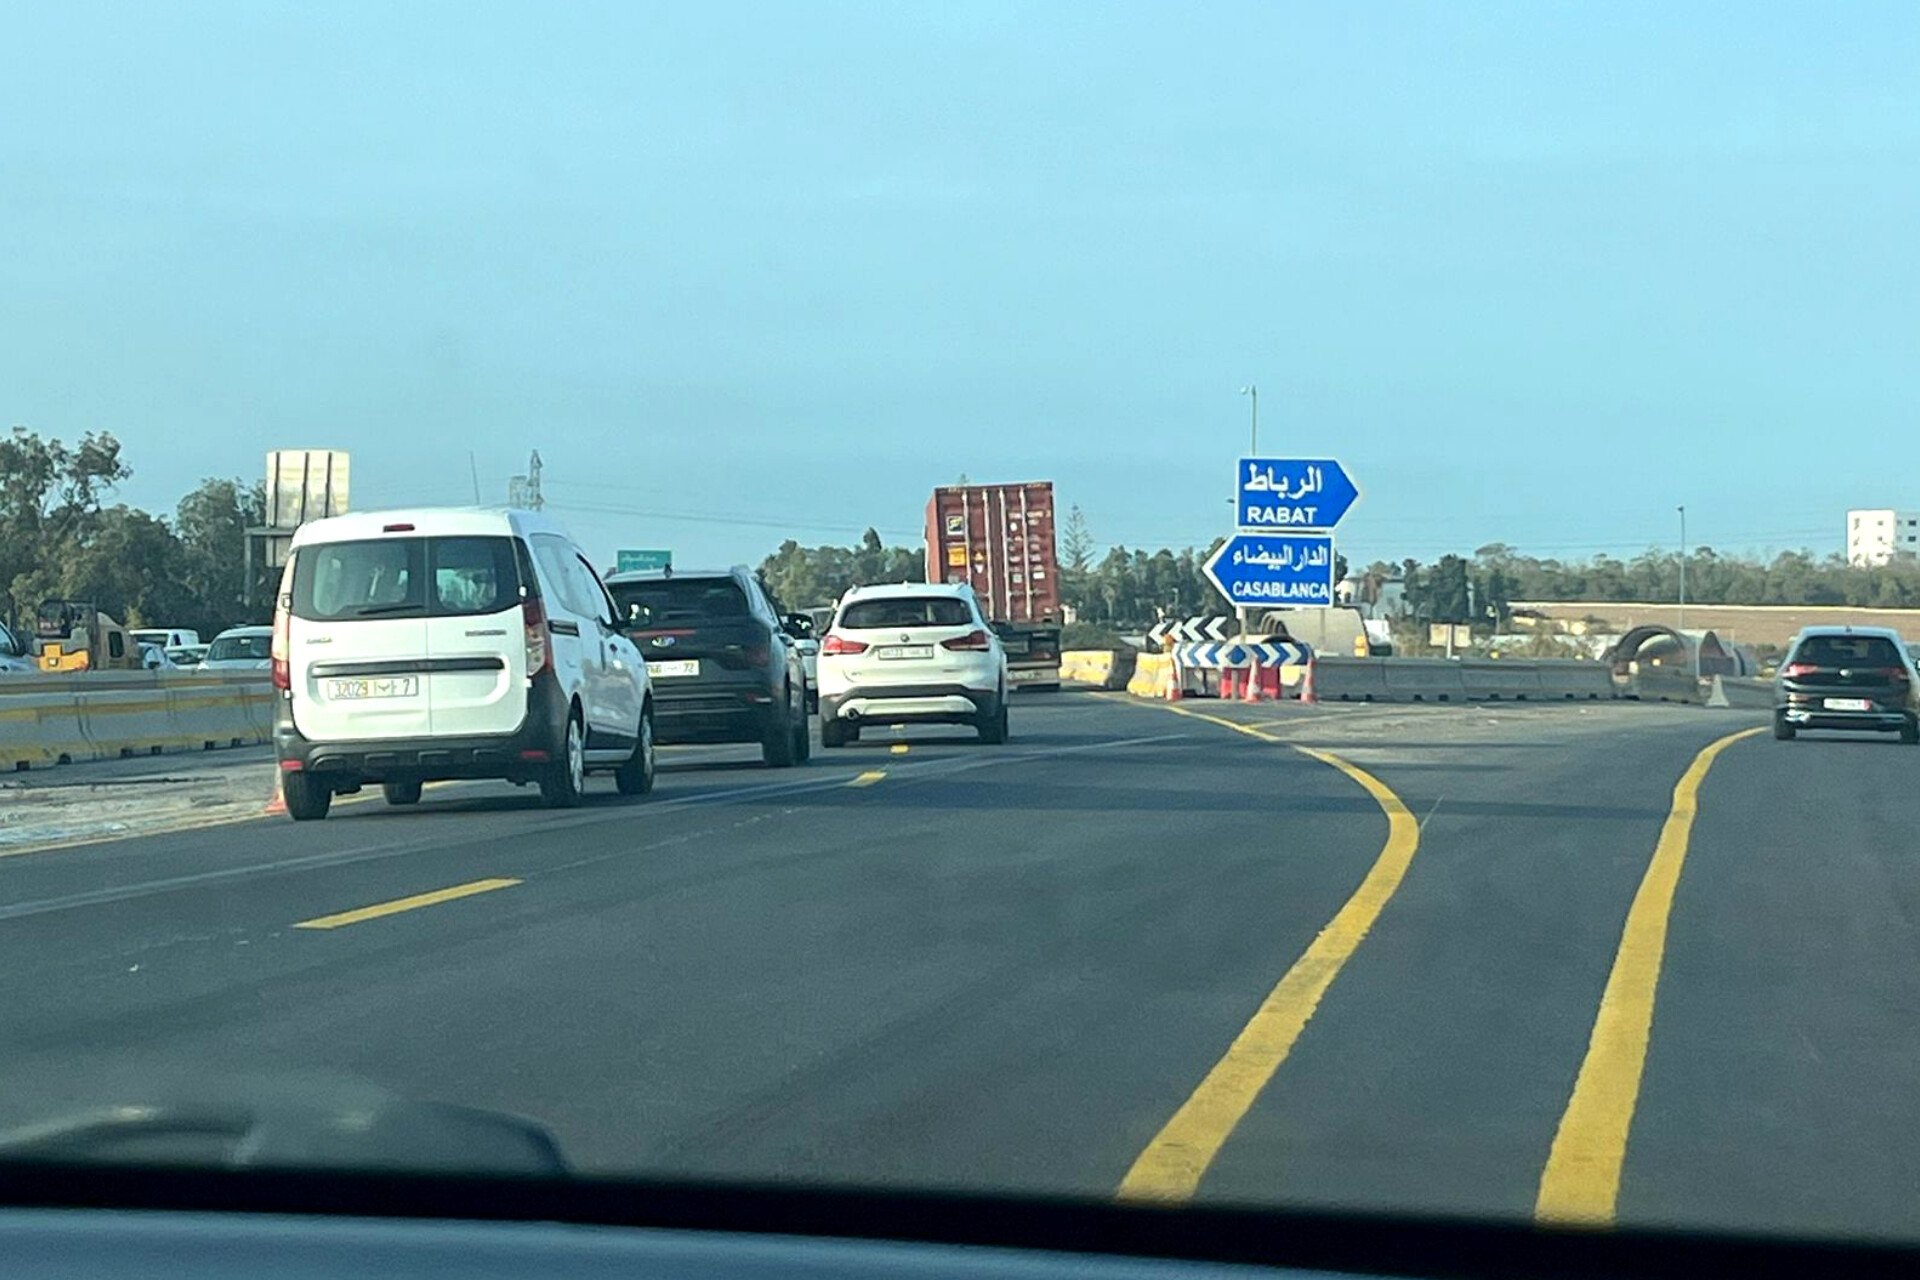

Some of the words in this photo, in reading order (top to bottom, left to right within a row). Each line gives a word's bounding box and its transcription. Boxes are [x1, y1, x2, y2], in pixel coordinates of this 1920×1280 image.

[1244, 463, 1322, 499] الرباط
[1247, 506, 1318, 524] RABAT
[1232, 544, 1293, 571] البيضاء
[1292, 544, 1328, 572] الدار
[1232, 581, 1330, 599] CASABLANCA
